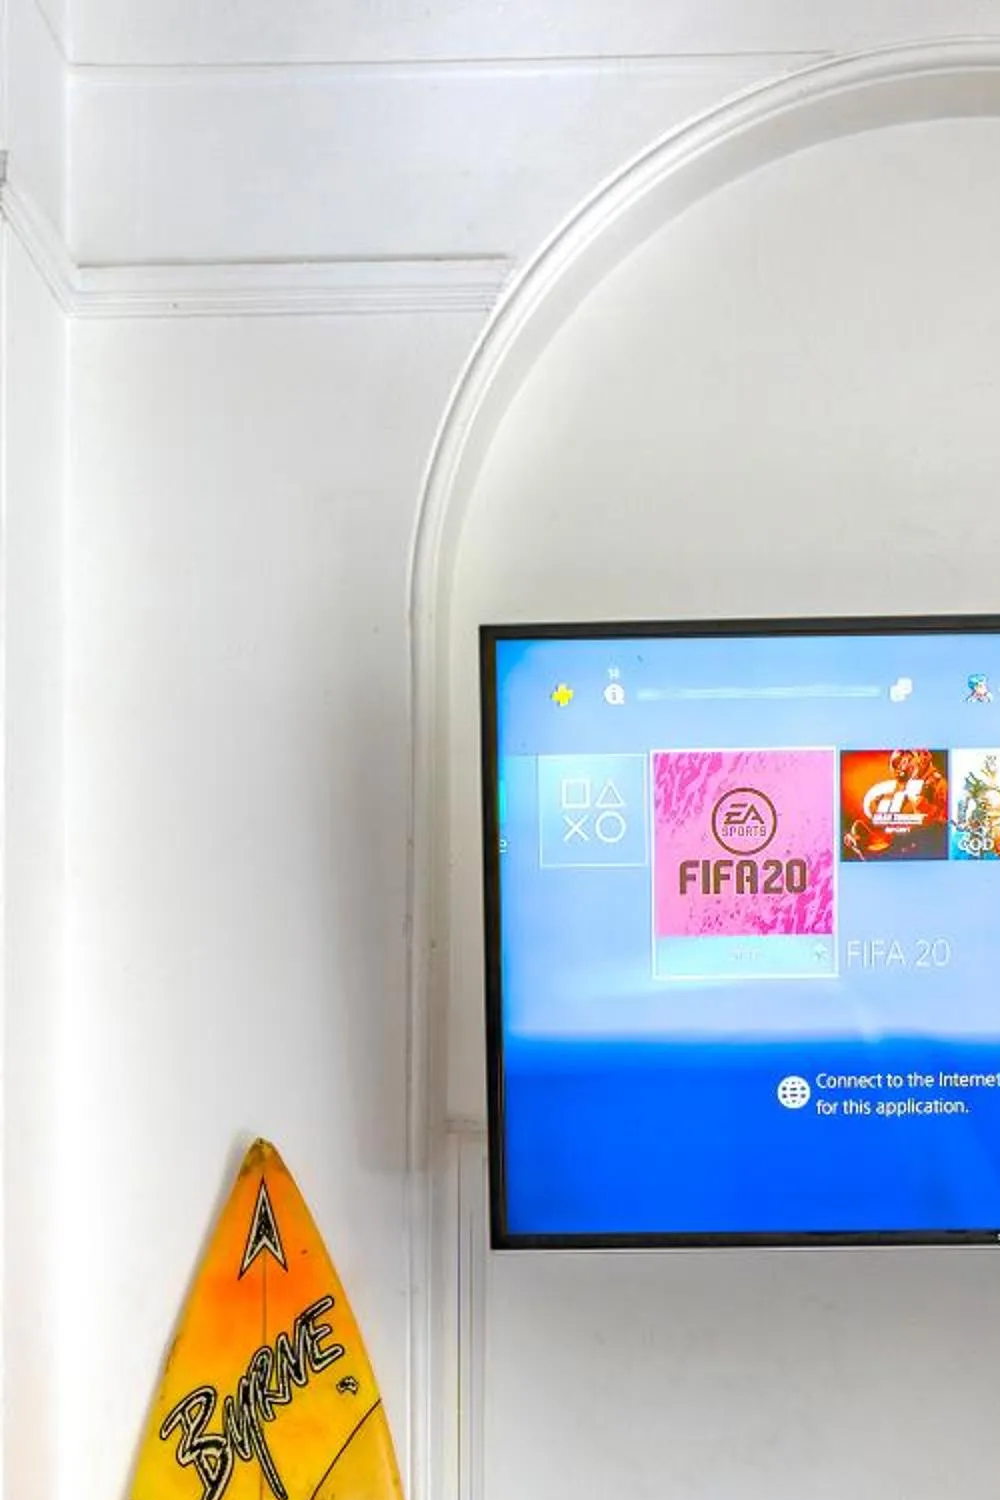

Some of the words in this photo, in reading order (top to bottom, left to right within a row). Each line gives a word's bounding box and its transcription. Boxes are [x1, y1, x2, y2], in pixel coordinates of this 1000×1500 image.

[723, 803, 764, 825] EA
[721, 826, 766, 837] SPORTS
[959, 836, 994, 853] GOD
[847, 940, 904, 968] FIFA
[916, 939, 950, 967] 20
[816, 1072, 883, 1089] Connect
[887, 1074, 903, 1088] to
[907, 1072, 935, 1088] the
[816, 1099, 838, 1115] for
[842, 1099, 871, 1115] this
[876, 1098, 969, 1117] application.
